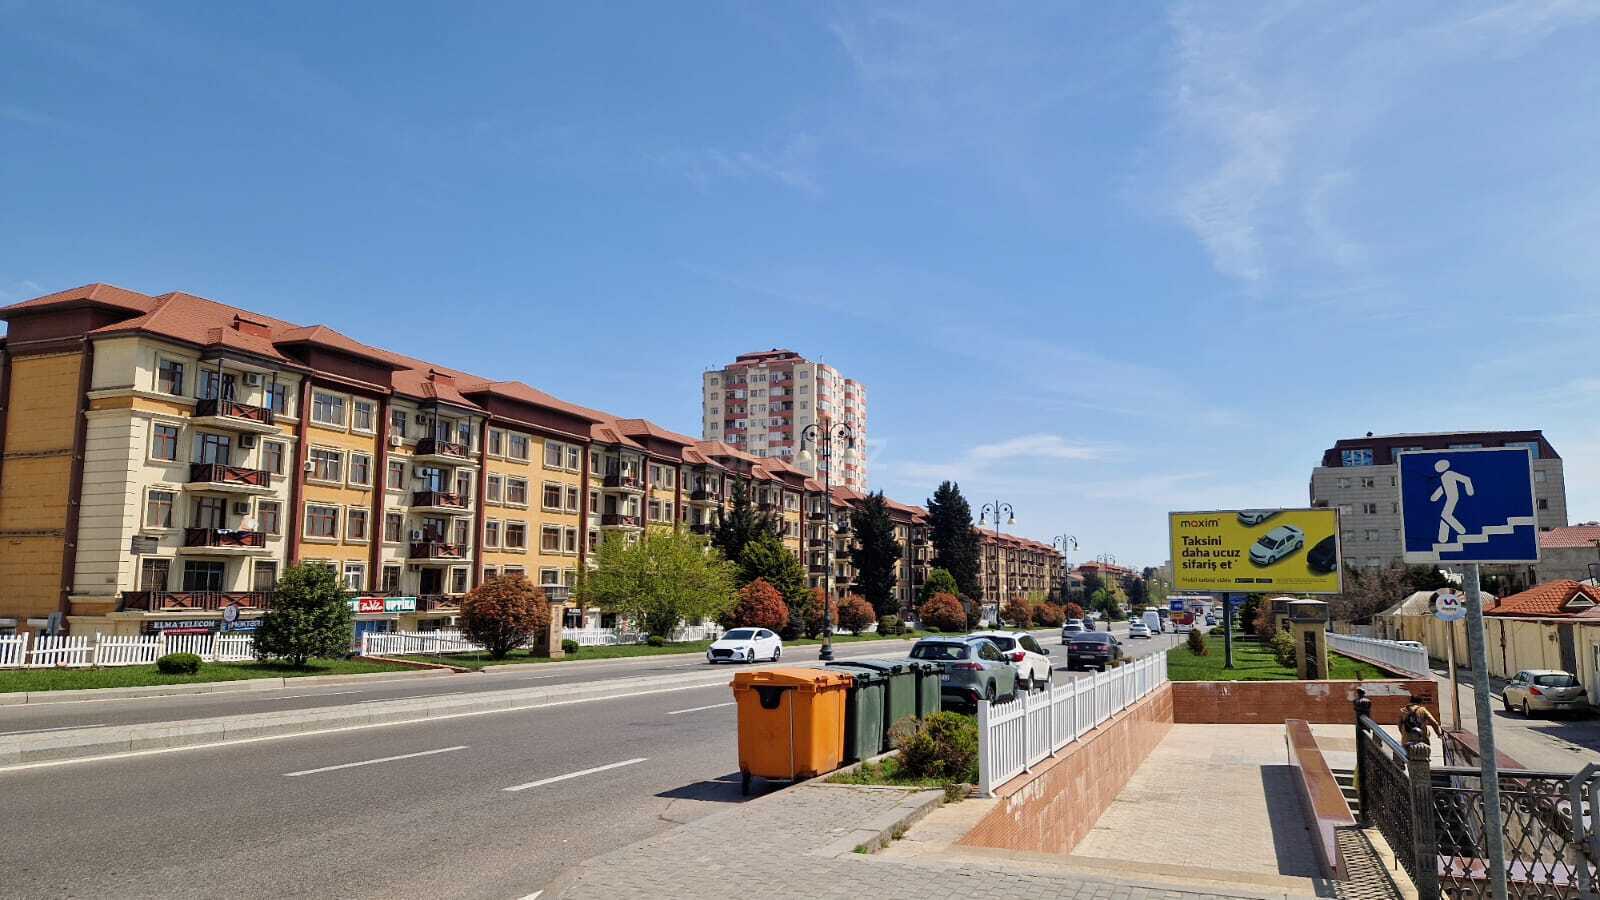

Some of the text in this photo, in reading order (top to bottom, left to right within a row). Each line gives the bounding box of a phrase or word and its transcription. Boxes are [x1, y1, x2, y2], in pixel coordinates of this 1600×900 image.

[1181, 536, 1222, 546] Taksini
[1182, 547, 1241, 558] daha ucuz
[1182, 559, 1217, 572] sifariş
[153, 620, 216, 629] ELMA TELECOM
